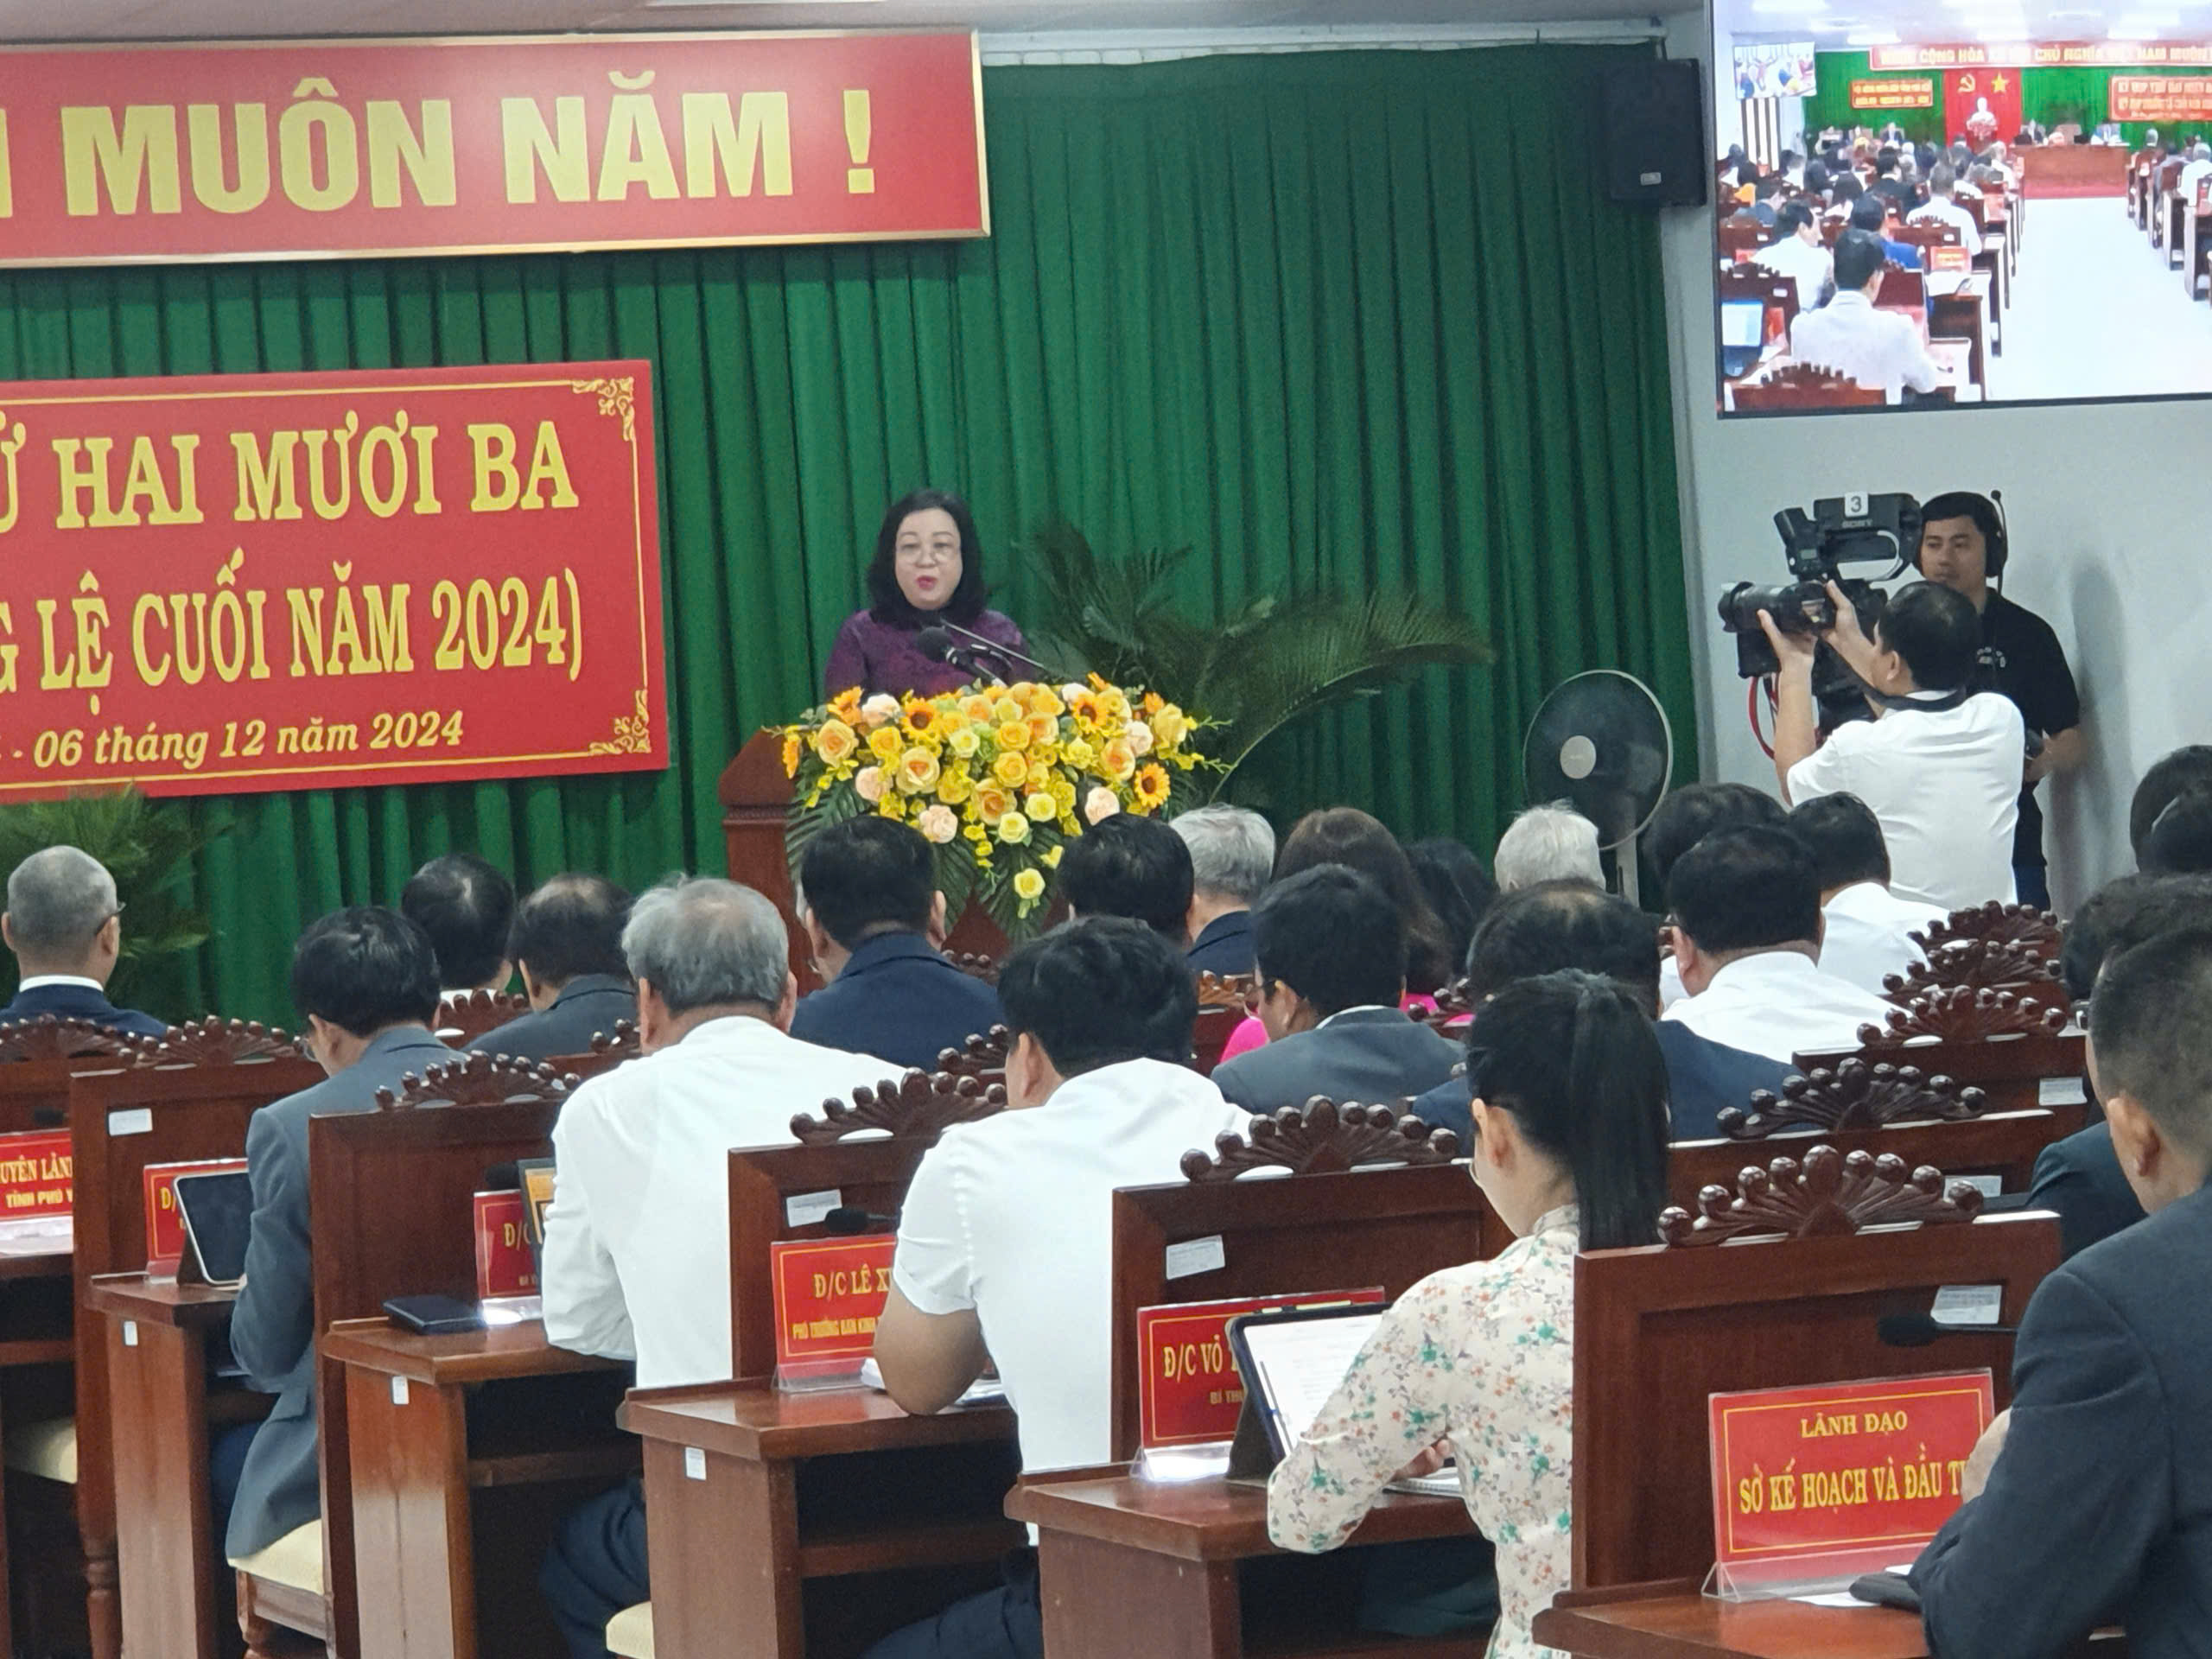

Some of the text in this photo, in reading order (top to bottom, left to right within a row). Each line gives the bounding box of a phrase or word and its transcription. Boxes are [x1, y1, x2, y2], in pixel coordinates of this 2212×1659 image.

[60, 77, 456, 216] MUÔN
[500, 70, 792, 204] NĂM
[843, 90, 874, 194] !
[52, 434, 204, 529] HAI
[230, 410, 442, 520] MƯƠI
[467, 420, 579, 512] BA
[1850, 495, 1862, 512] 3
[35, 570, 113, 715] LỆ
[132, 546, 270, 686] CUỐI
[286, 559, 414, 677] NĂM
[432, 567, 582, 681] 2024)
[34, 728, 84, 768] 06
[95, 721, 209, 770] tháng
[219, 720, 265, 758] 12
[276, 717, 359, 754] năm
[371, 710, 464, 748] 2024
[814, 1271, 847, 1301] Đ/C
[850, 1262, 872, 1294] LÊ
[1163, 1343, 1196, 1383] Đ/C
[1800, 1410, 1908, 1438] LÃNH ĐẠO
[1769, 1457, 1796, 1510] KẾ
[1802, 1468, 1868, 1514] HOẠCH
[1872, 1456, 1900, 1501] VÀ
[1904, 1441, 1942, 1499] ĐẦU
[1948, 1460, 1967, 1496] T
